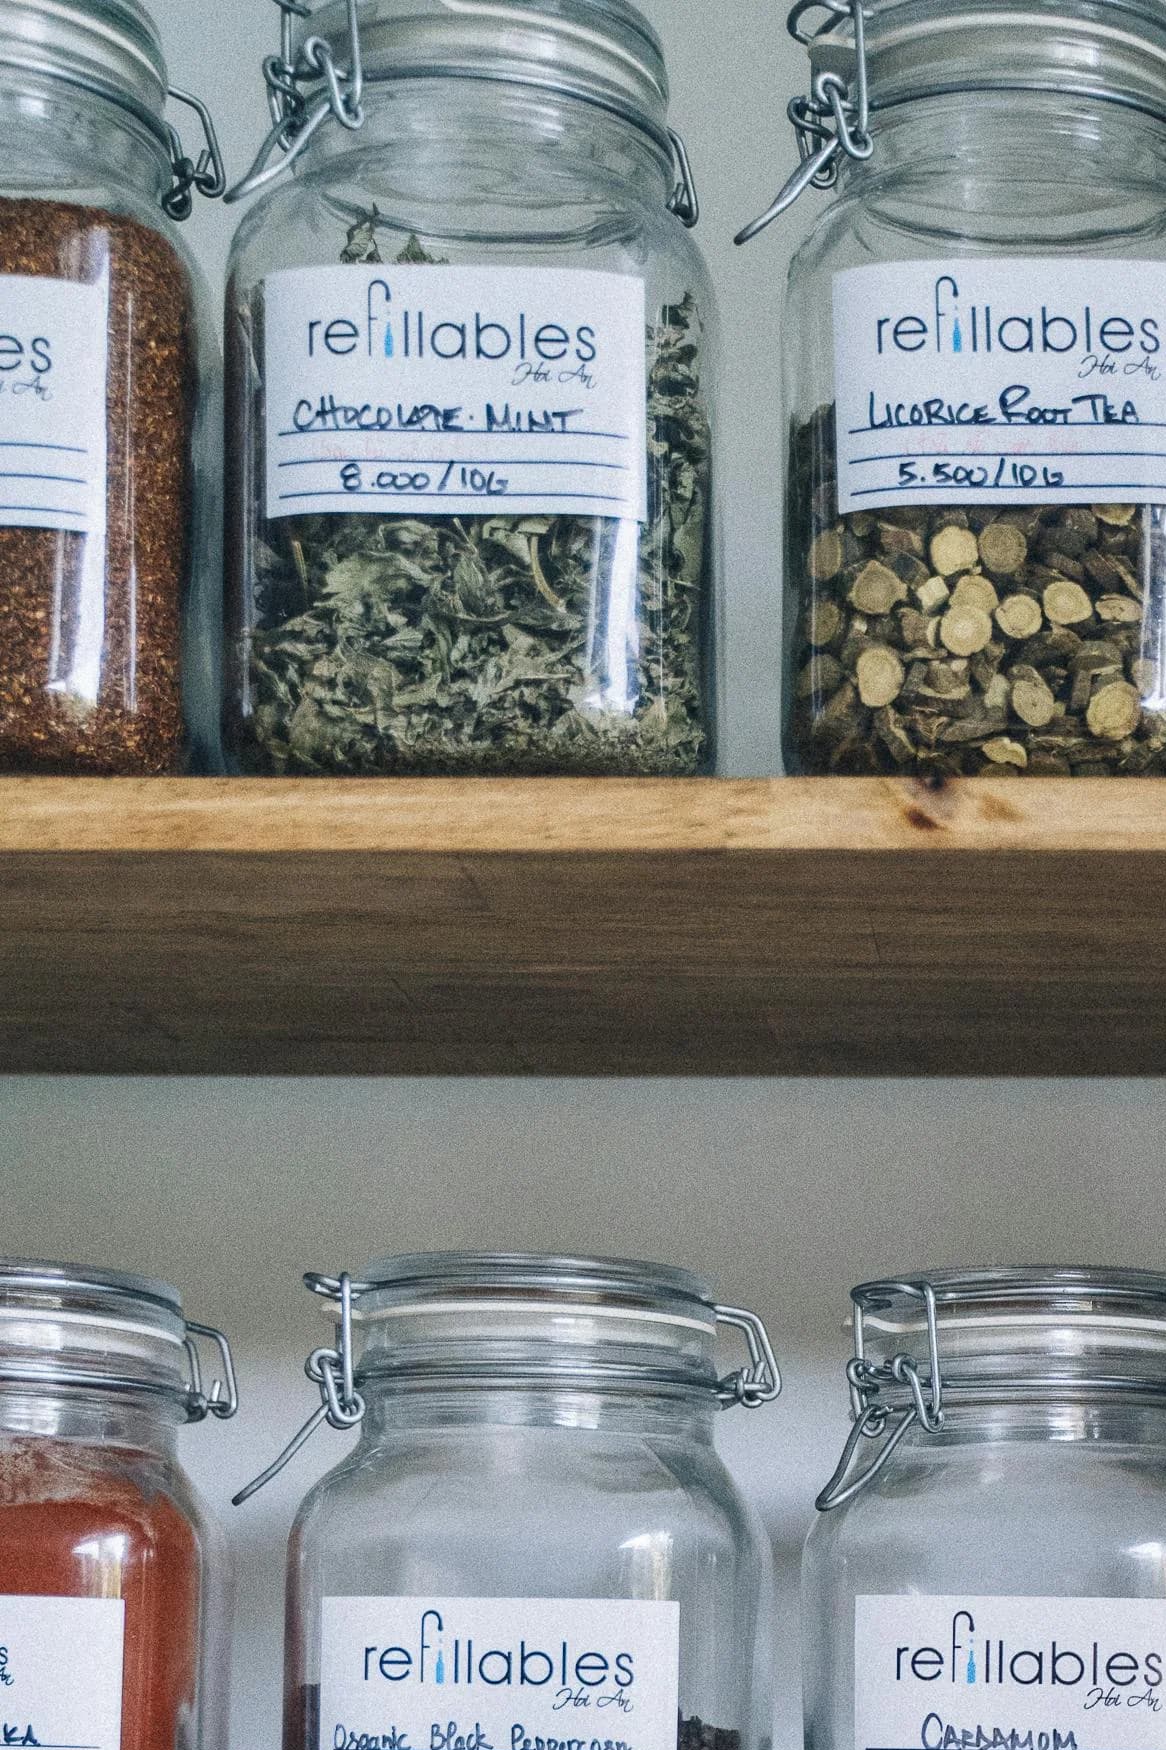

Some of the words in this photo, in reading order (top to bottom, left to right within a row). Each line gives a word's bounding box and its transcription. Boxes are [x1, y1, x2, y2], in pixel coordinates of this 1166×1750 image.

[308, 279, 597, 362] refillables
[877, 276, 1160, 354] refillables
[486, 403, 583, 432] MINT
[870, 391, 996, 429] LICORICE
[1000, 384, 1072, 424] ROOT
[1072, 394, 1139, 424] TEA
[363, 1610, 635, 1687] refillables
[896, 1610, 1162, 1687] refillables
[430, 1722, 493, 1750] Black
